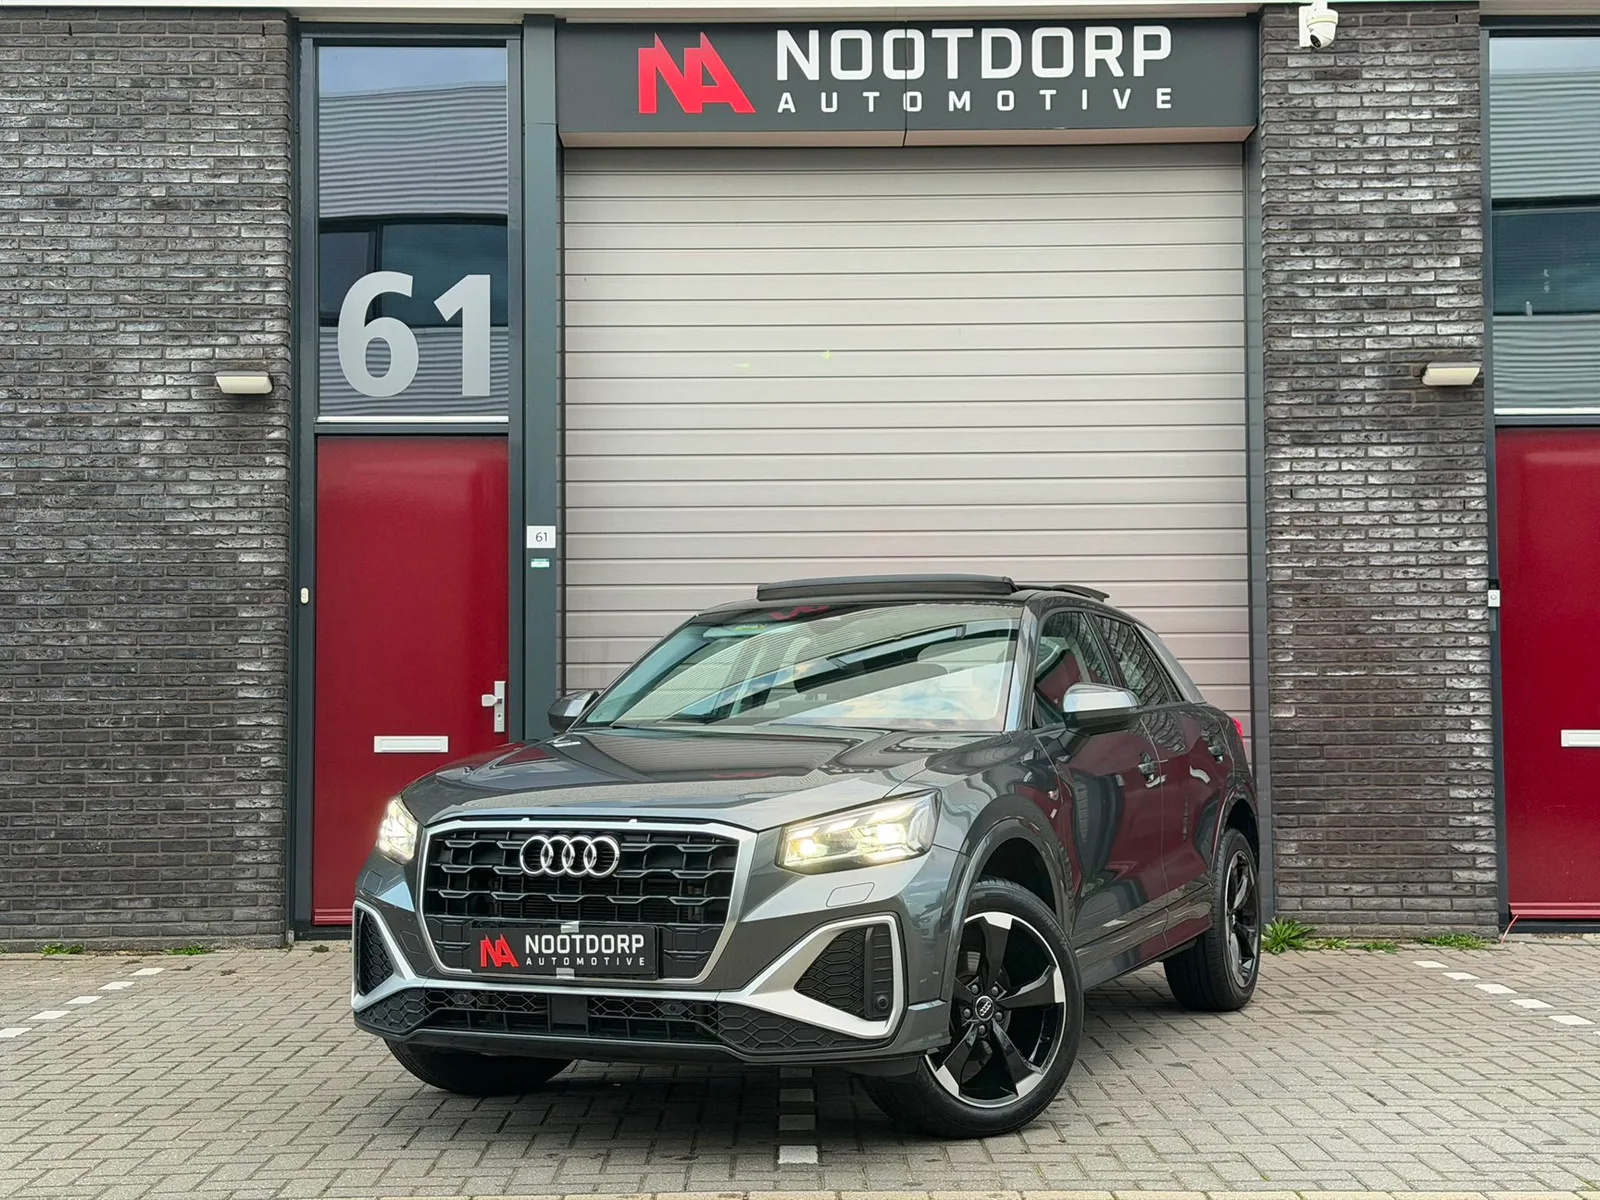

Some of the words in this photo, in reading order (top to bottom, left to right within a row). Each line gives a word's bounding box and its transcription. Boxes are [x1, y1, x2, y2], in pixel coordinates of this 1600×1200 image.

[776, 25, 1172, 81] NOOTDORP
[777, 87, 1172, 114] AUTOMOTIVE
[337, 270, 491, 397] 61
[535, 531, 548, 543] 61
[525, 934, 645, 955] NOOTDORP
[525, 956, 645, 966] AUTOMOTIVE
